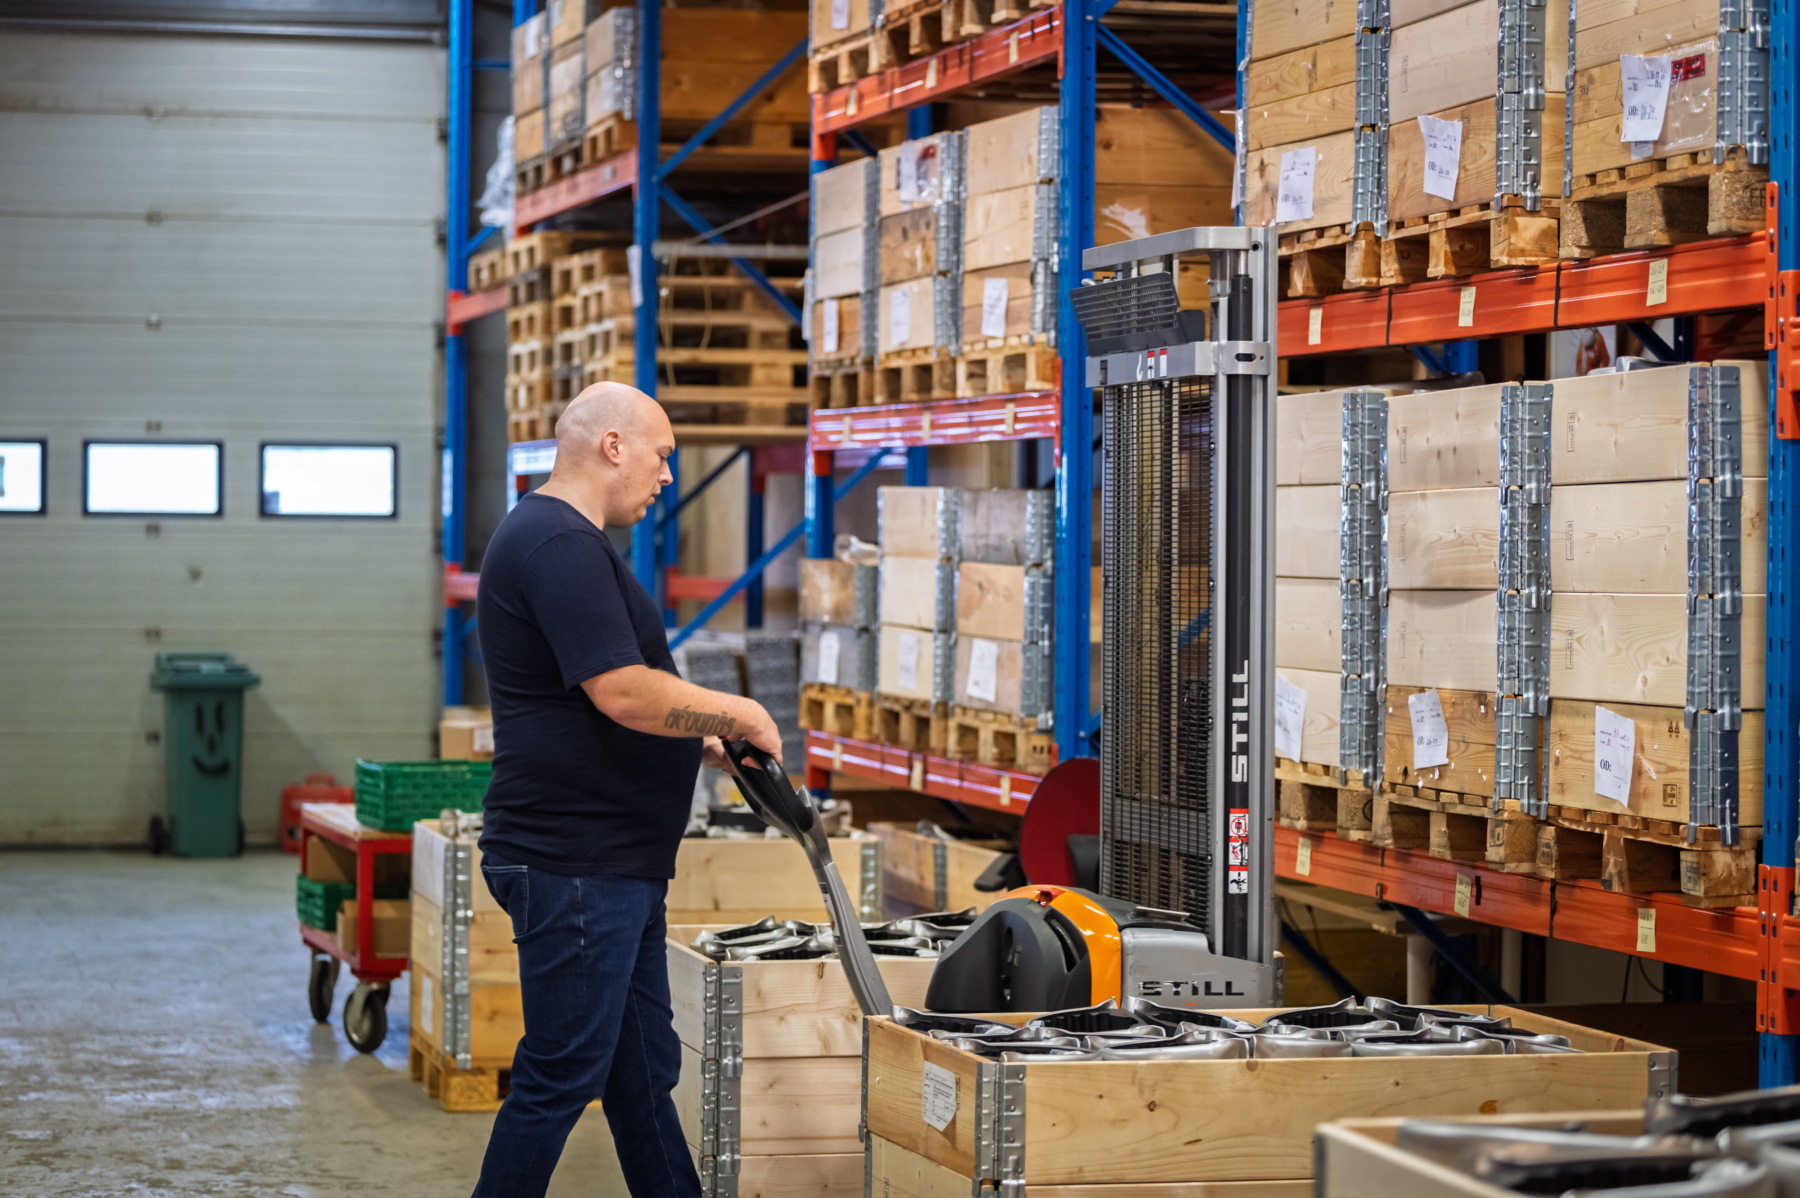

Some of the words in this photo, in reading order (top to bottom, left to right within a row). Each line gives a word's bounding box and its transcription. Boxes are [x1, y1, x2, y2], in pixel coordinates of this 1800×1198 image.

[1628, 105, 1638, 116] OD:
[1231, 659, 1249, 783] STILL
[1600, 758, 1612, 772] OD:
[1139, 980, 1244, 996] STILL
